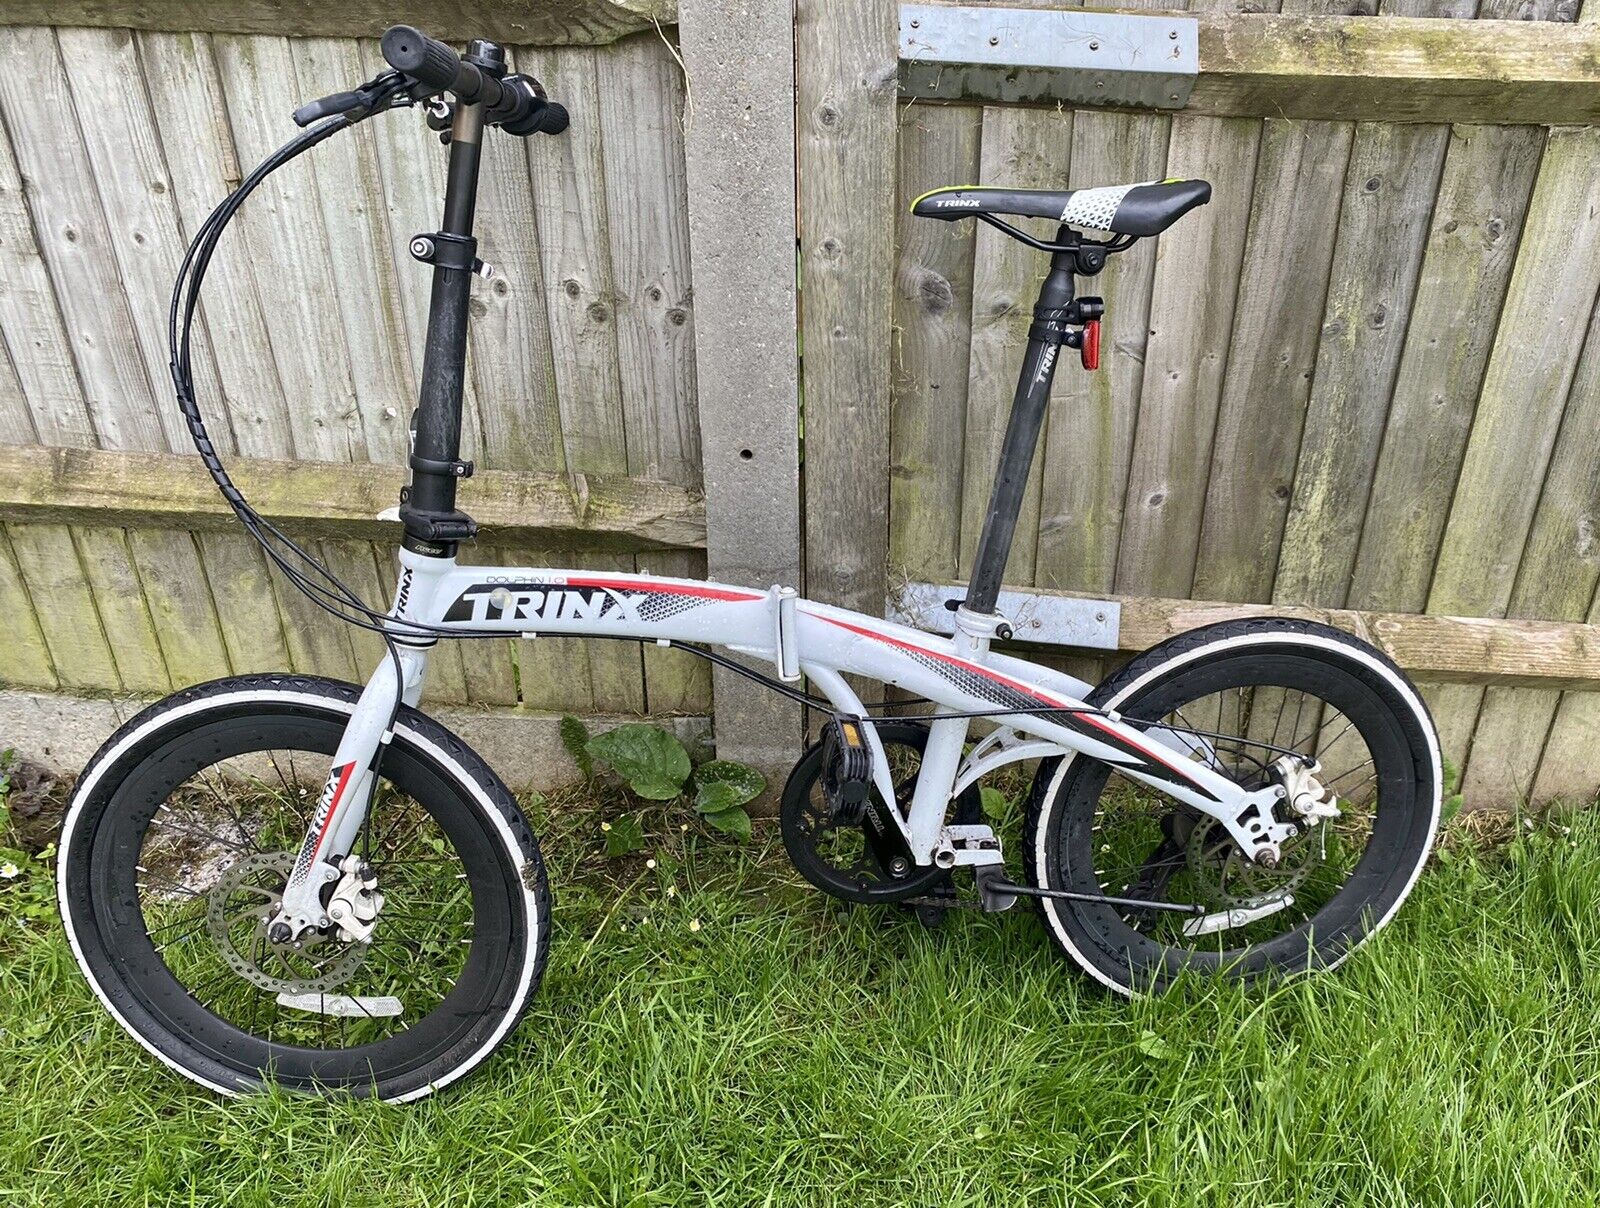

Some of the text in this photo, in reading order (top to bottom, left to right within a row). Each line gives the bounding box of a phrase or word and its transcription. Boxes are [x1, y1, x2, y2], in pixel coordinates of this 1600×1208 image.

[936, 199, 981, 208] TRINX
[462, 587, 651, 624] TRINX
[309, 770, 341, 836] TRINX
